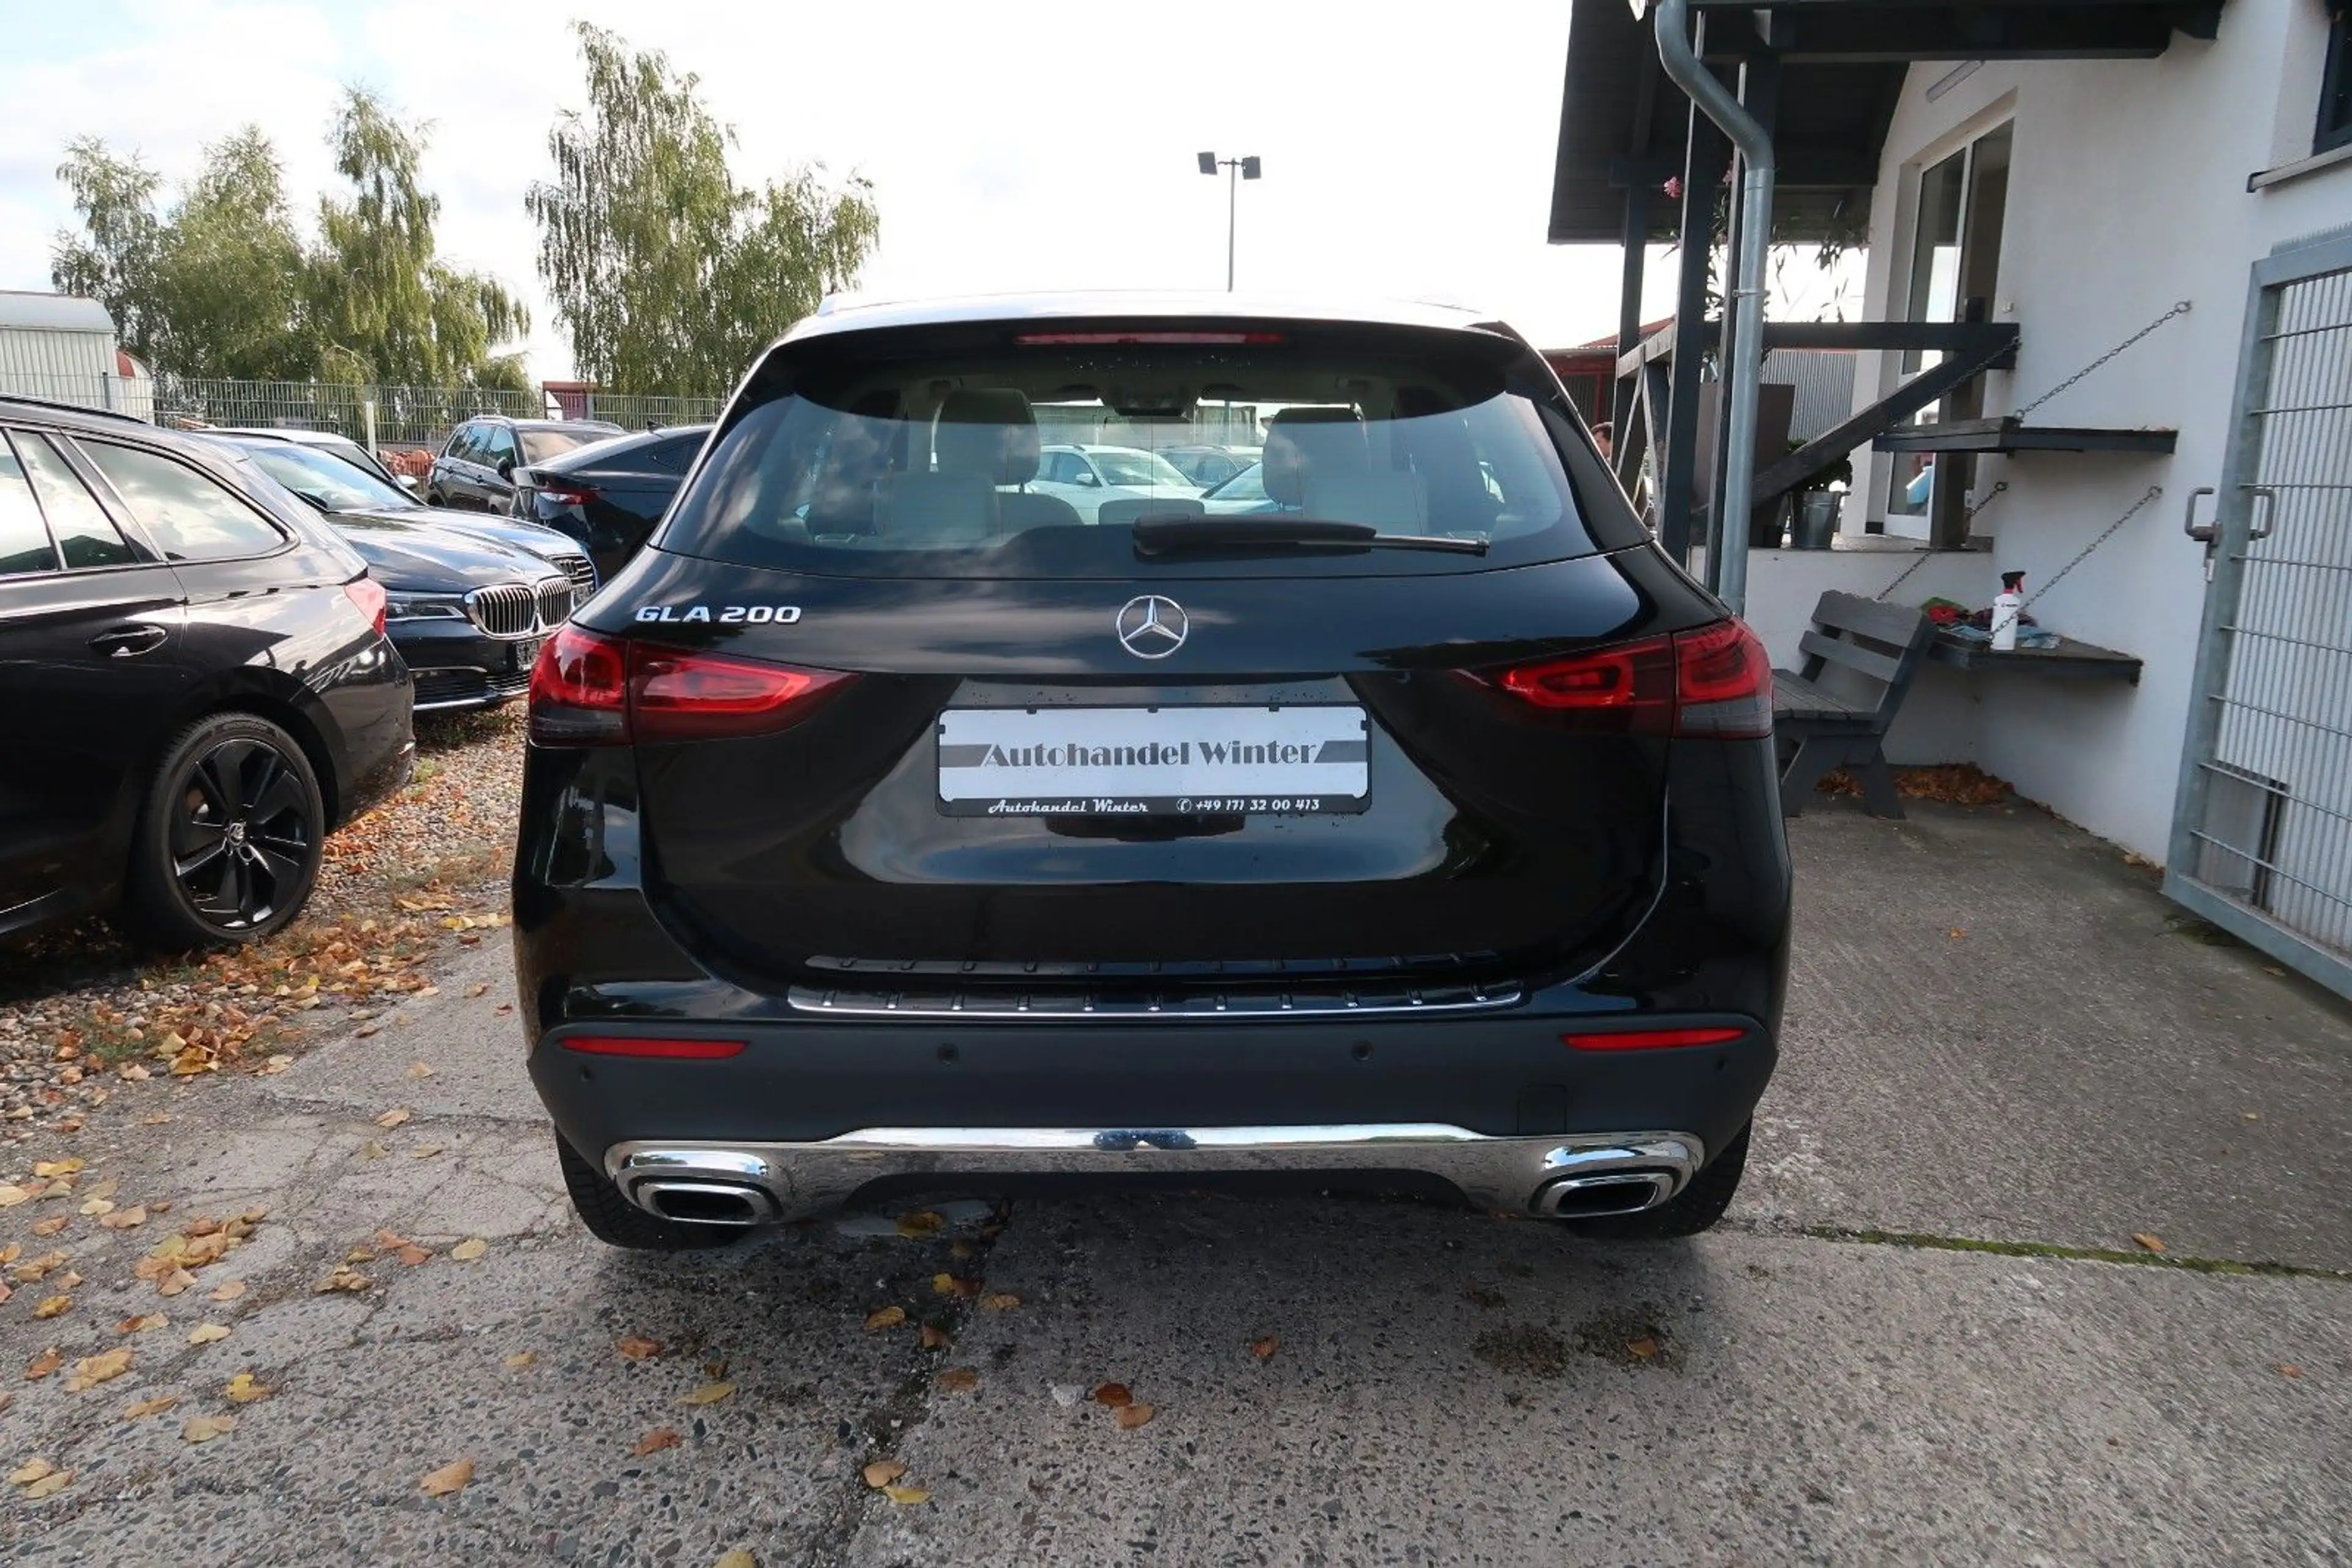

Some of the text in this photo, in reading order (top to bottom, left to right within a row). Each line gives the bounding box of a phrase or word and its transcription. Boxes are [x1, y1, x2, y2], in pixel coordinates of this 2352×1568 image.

[635, 605, 802, 624] GLA 200
[982, 741, 1316, 766] Autohandel Winter
[988, 798, 1148, 813] Autohandel Winter
[1196, 799, 1320, 811] +49 171 32 00 413
